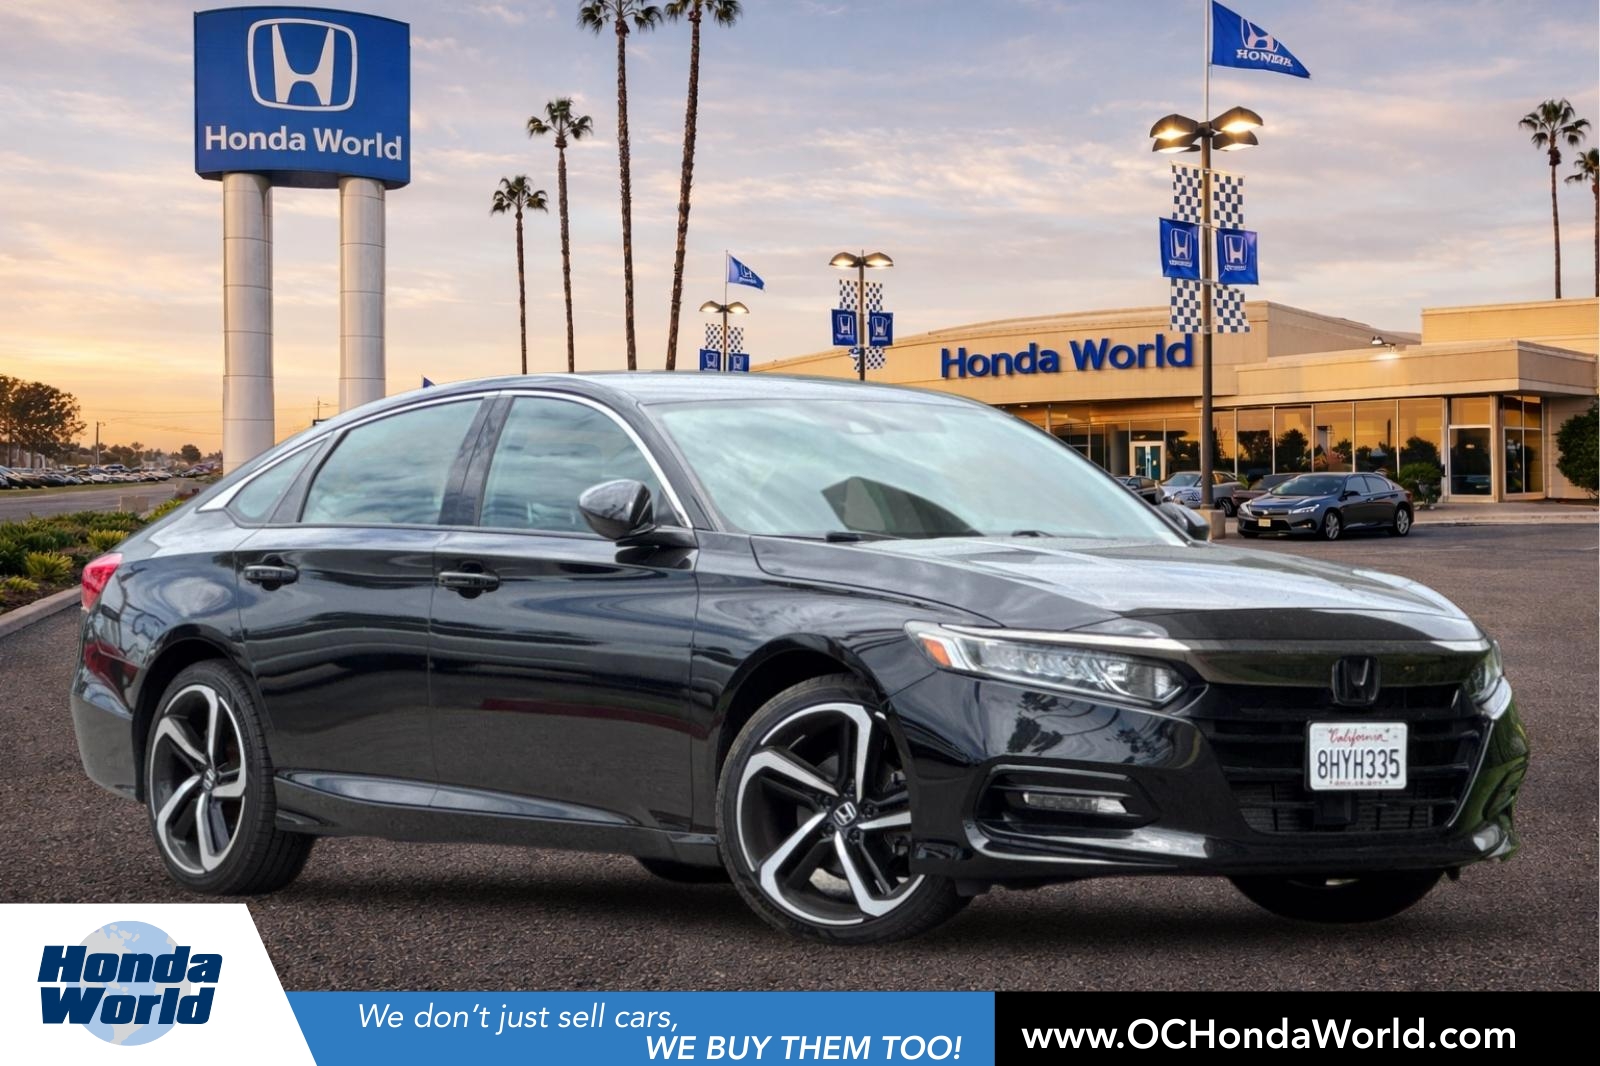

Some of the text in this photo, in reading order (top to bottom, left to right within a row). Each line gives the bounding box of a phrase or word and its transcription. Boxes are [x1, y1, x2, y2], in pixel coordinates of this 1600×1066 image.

[205, 125, 402, 161] Honda World
[941, 333, 1194, 378] Honda World
[1329, 728, 1388, 747] California
[1317, 749, 1400, 779] 8HYH335
